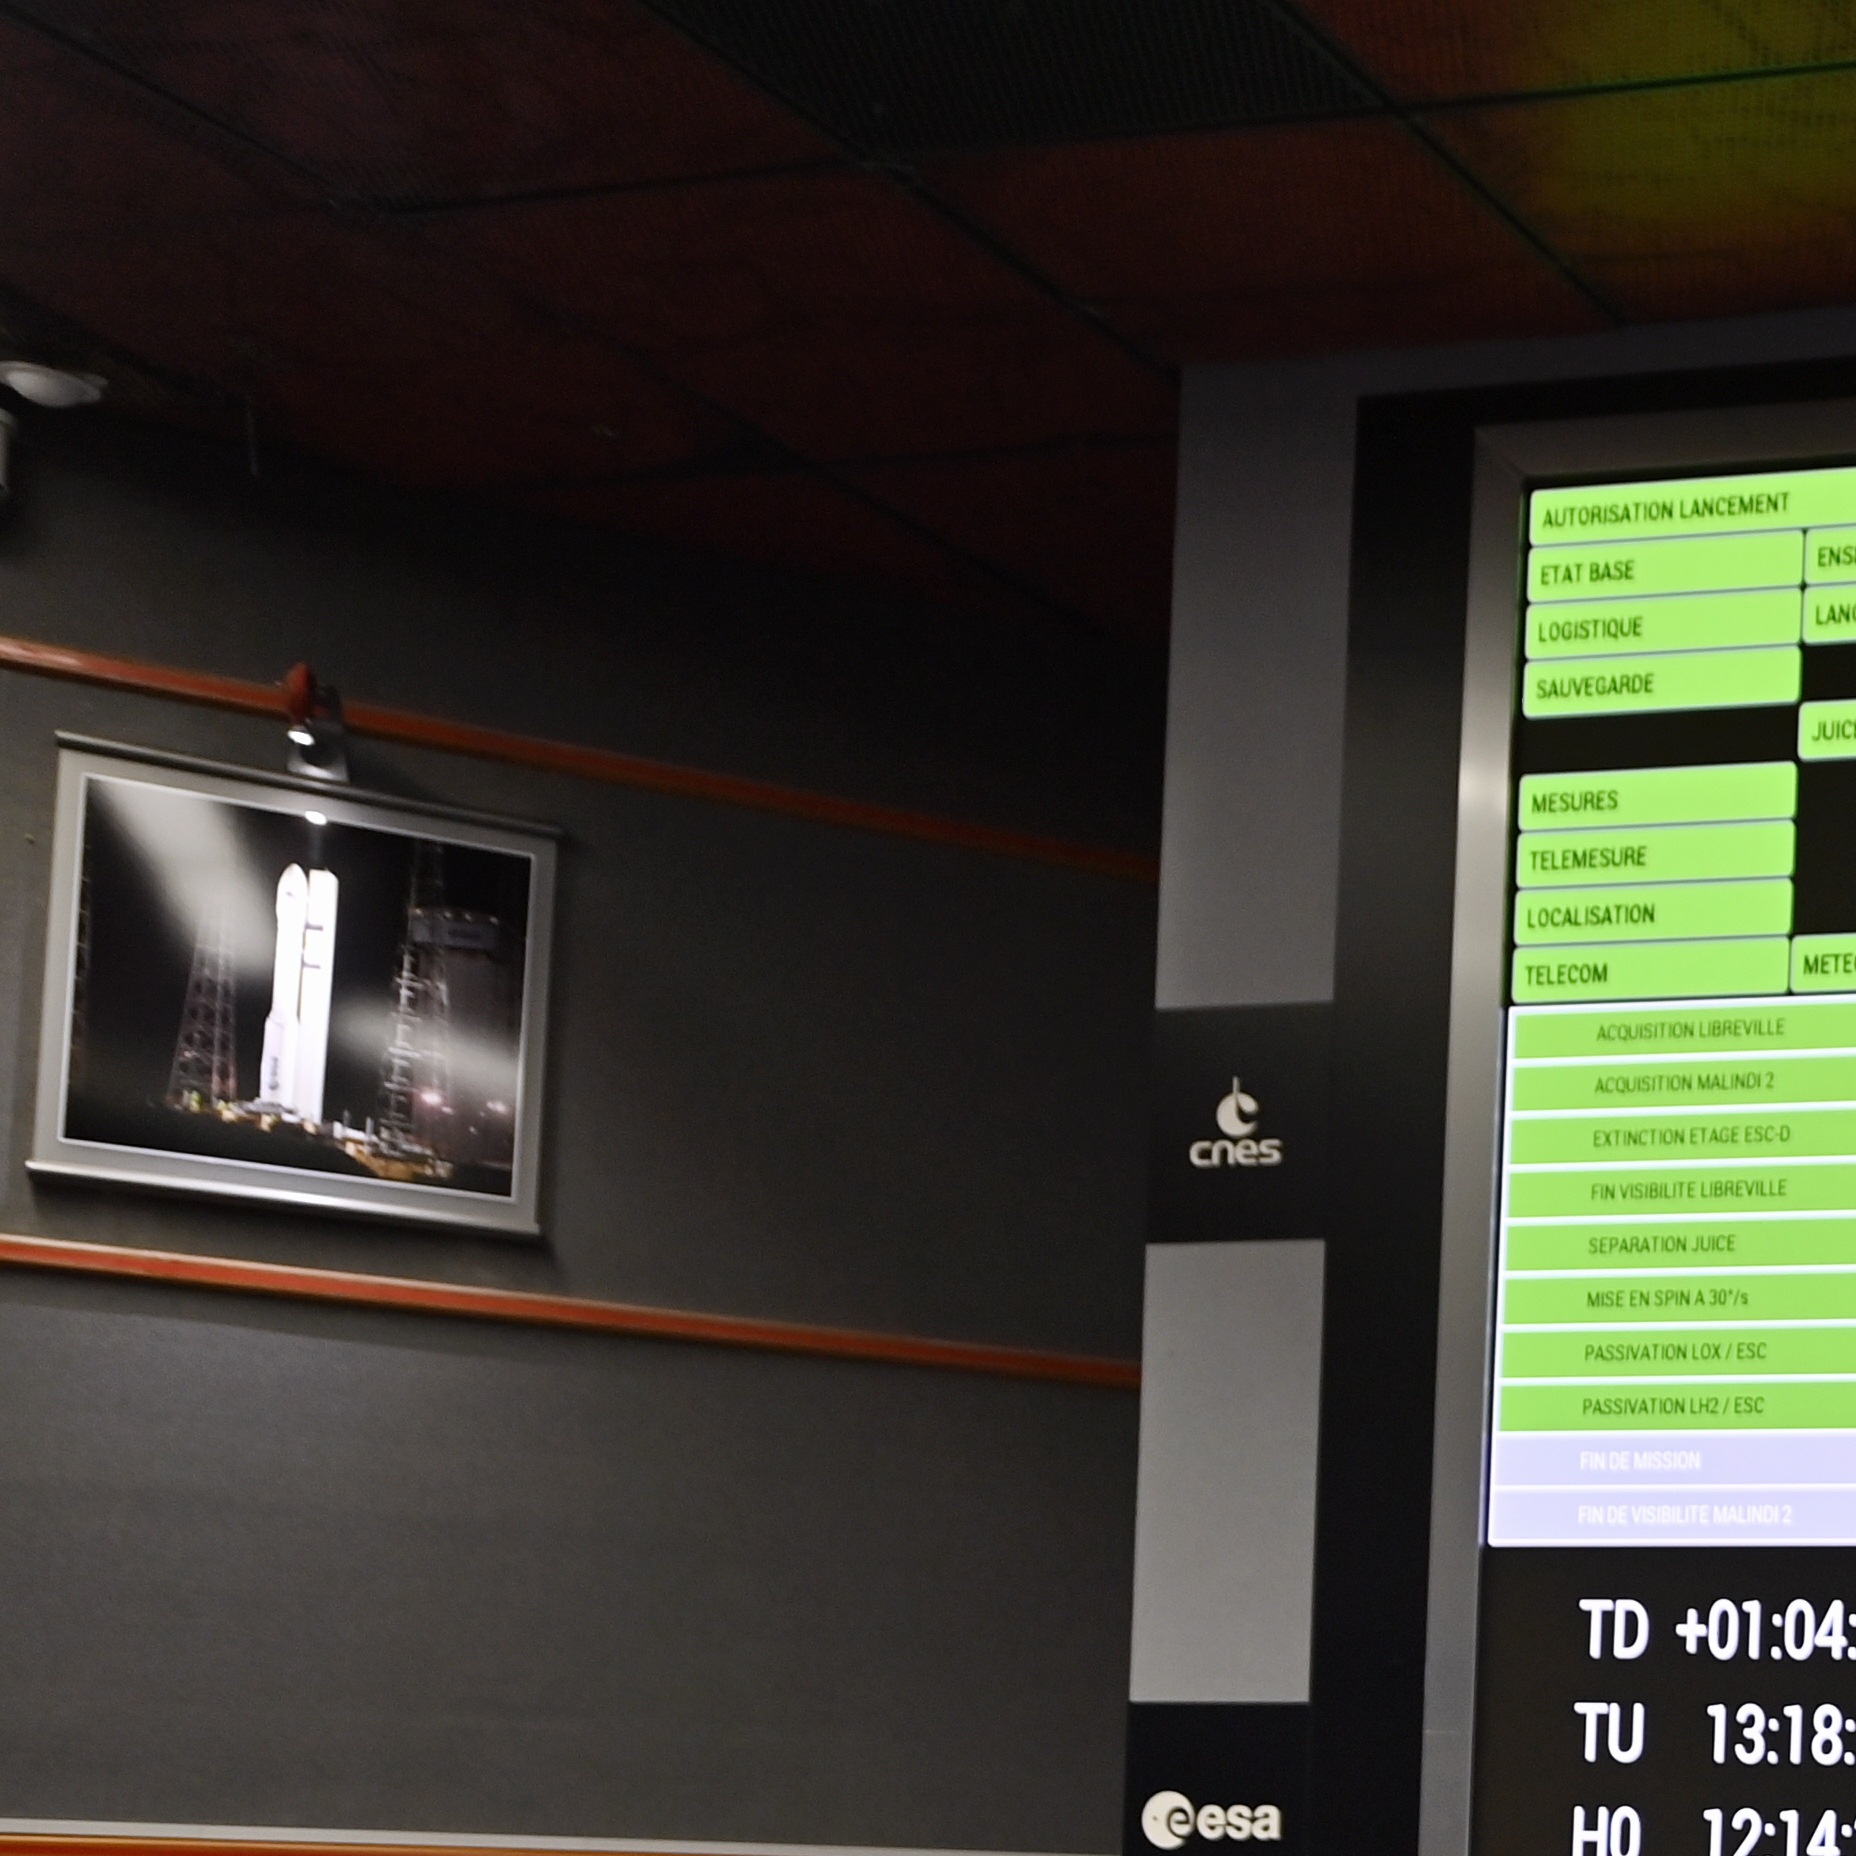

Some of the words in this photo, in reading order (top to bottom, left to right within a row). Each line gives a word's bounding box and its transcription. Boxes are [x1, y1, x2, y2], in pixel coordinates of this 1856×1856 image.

[1542, 500, 1673, 528] AUTORISATION
[1679, 492, 1790, 520] LANCEMENT
[1541, 563, 1583, 584] ETAT
[1589, 560, 1635, 582] BASE
[1538, 617, 1643, 642] LOGISTIQUE
[1536, 674, 1655, 699] SAUVEGARDE
[1531, 790, 1619, 813] MESURES
[1530, 846, 1648, 871] TELEMESURE
[1527, 903, 1656, 929] LOCALISATION
[1525, 963, 1609, 985] TELECOM
[1596, 1021, 1695, 1042] ACQUISITION
[1698, 1018, 1785, 1039] LIBREVILLE
[1594, 1074, 1693, 1094] ACQUISITION
[1697, 1072, 1762, 1092] MALINDI
[1764, 1071, 1775, 1090] 2
[1593, 1127, 1685, 1148] EXTINCTION
[1689, 1125, 1740, 1145] ETAGE
[1744, 1125, 1792, 1144] ESC-D
[1190, 1137, 1281, 1167] cnes
[1591, 1182, 1616, 1201] FIN
[1618, 1180, 1696, 1200] VISIBILITE
[1700, 1179, 1788, 1198] LIBREVILLE
[1588, 1236, 1688, 1256] SEPARATION
[1691, 1234, 1736, 1254] JUICE
[1586, 1290, 1625, 1309] MISE
[1629, 1290, 1651, 1308] EN
[1654, 1289, 1691, 1308] SPIN
[1694, 1289, 1705, 1307] A
[1584, 1343, 1688, 1362] PASSIVATION
[1691, 1342, 1722, 1361] LOX
[1736, 1341, 1768, 1360] ESC
[1582, 1397, 1686, 1417] PASSIVATION
[1689, 1396, 1720, 1416] LH2
[1733, 1395, 1765, 1415] ESC
[1579, 1598, 1650, 1660] TD
[1573, 1702, 1645, 1763] TU
